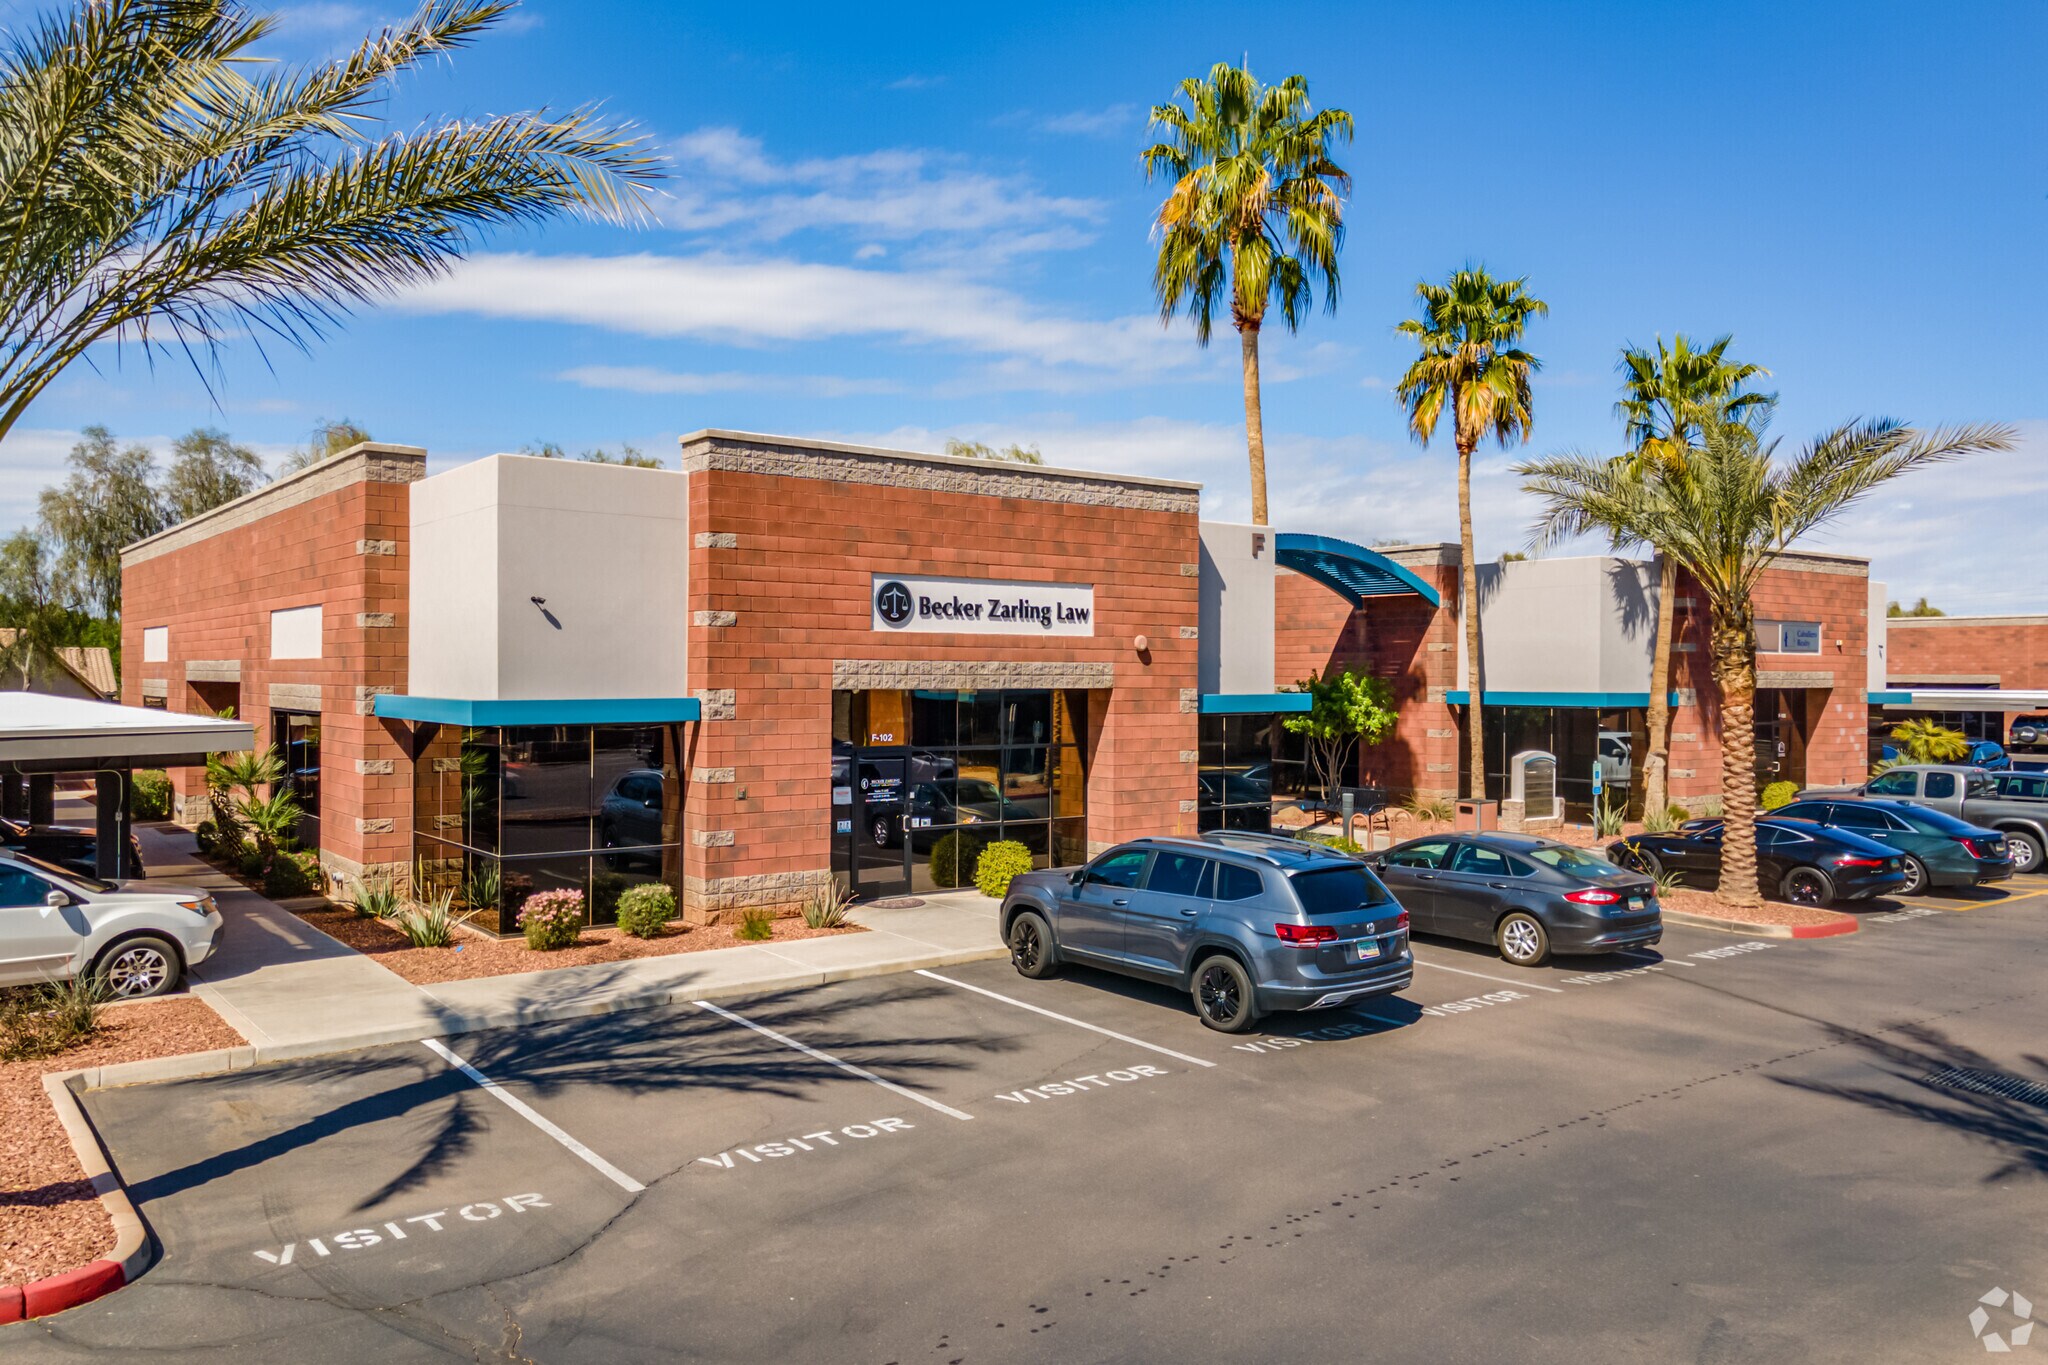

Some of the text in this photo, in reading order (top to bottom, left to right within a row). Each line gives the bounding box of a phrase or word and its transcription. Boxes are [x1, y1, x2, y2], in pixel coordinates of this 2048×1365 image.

[1251, 532, 1265, 560] F
[918, 595, 1091, 626] Becker Zarling Law
[871, 733, 894, 743] F-102
[1421, 990, 1530, 1017] VISITOR
[1232, 1022, 1373, 1054] VISITOR
[994, 1063, 1169, 1104] VISITOR
[697, 1115, 915, 1169] VISITOR
[253, 1192, 552, 1266] VISITOR
